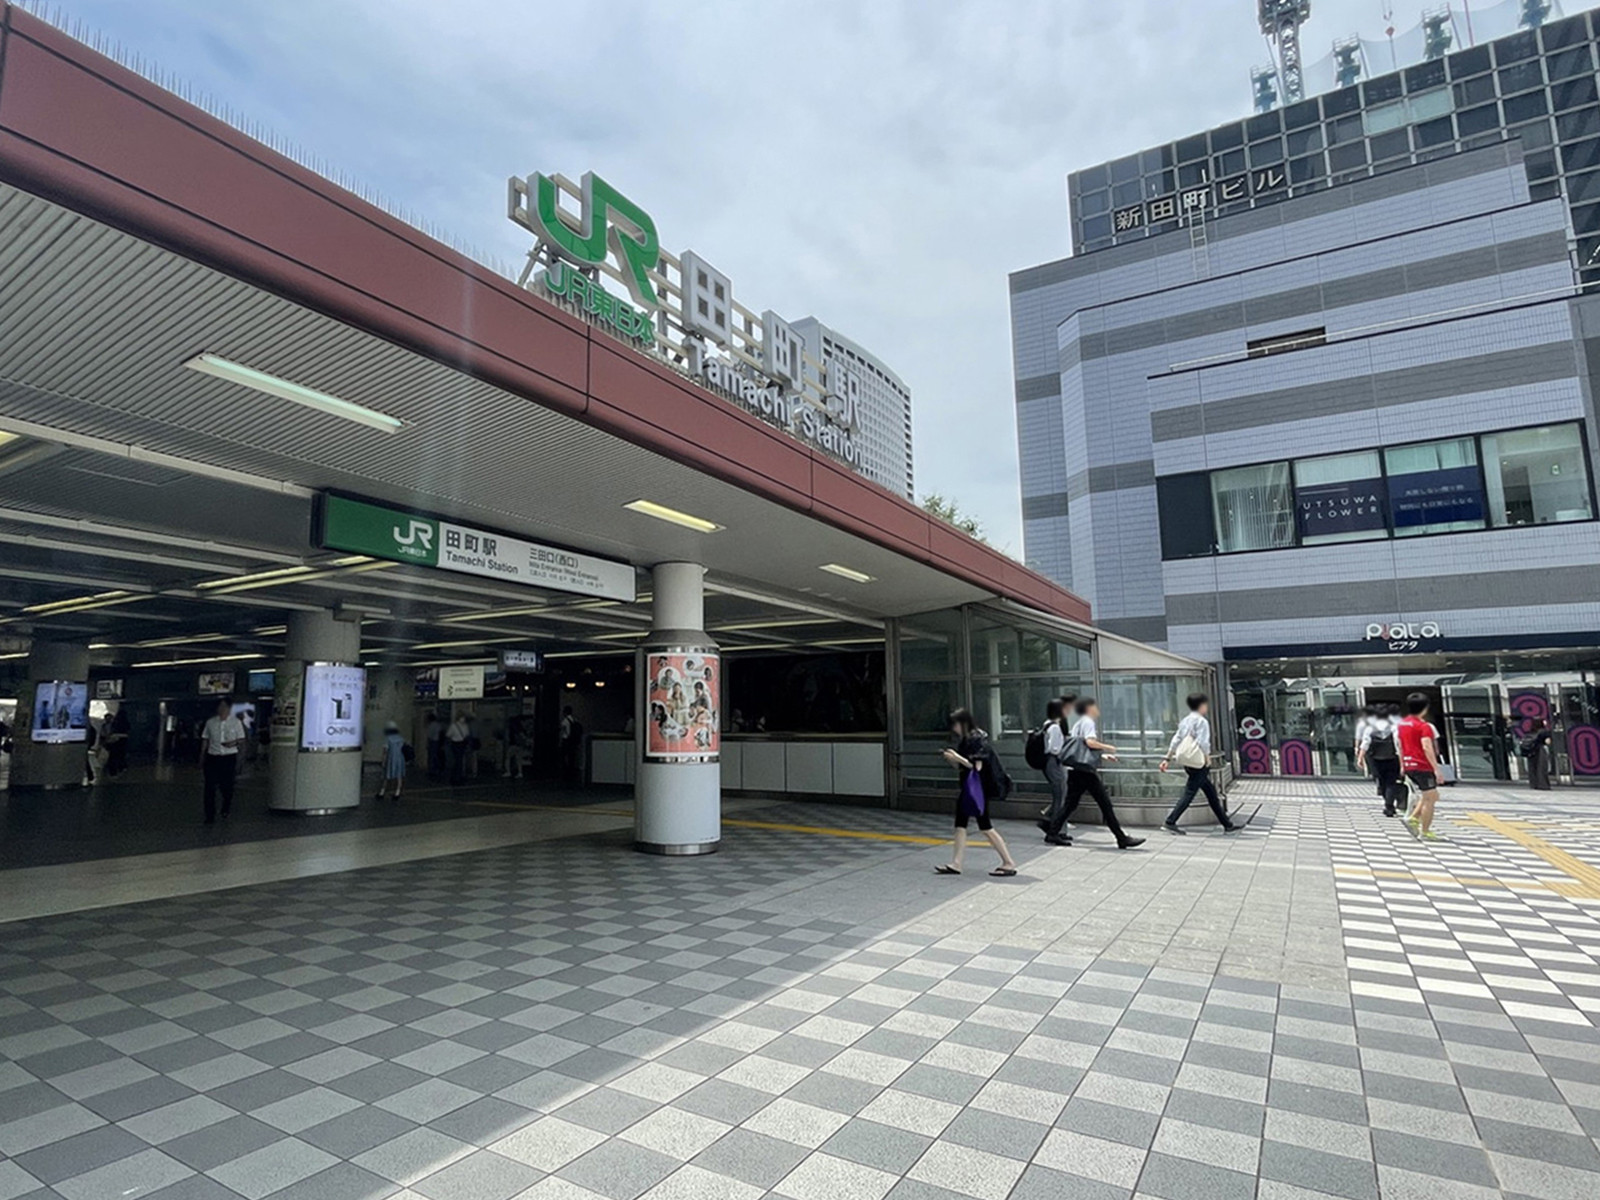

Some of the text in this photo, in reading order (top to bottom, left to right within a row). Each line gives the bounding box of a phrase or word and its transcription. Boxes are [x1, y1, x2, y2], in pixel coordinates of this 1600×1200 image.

[1116, 170, 1284, 230] 新田町ビル
[528, 171, 660, 312] JR
[544, 261, 655, 343] JR東日本
[682, 249, 862, 432] 田町駅
[688, 336, 863, 466] Tamachi Station
[1303, 495, 1376, 510] UTSUWA
[1305, 506, 1376, 520] FLOWER
[393, 520, 433, 550] JR
[446, 529, 497, 557] 田町駅
[446, 550, 518, 574] Tamachi Station
